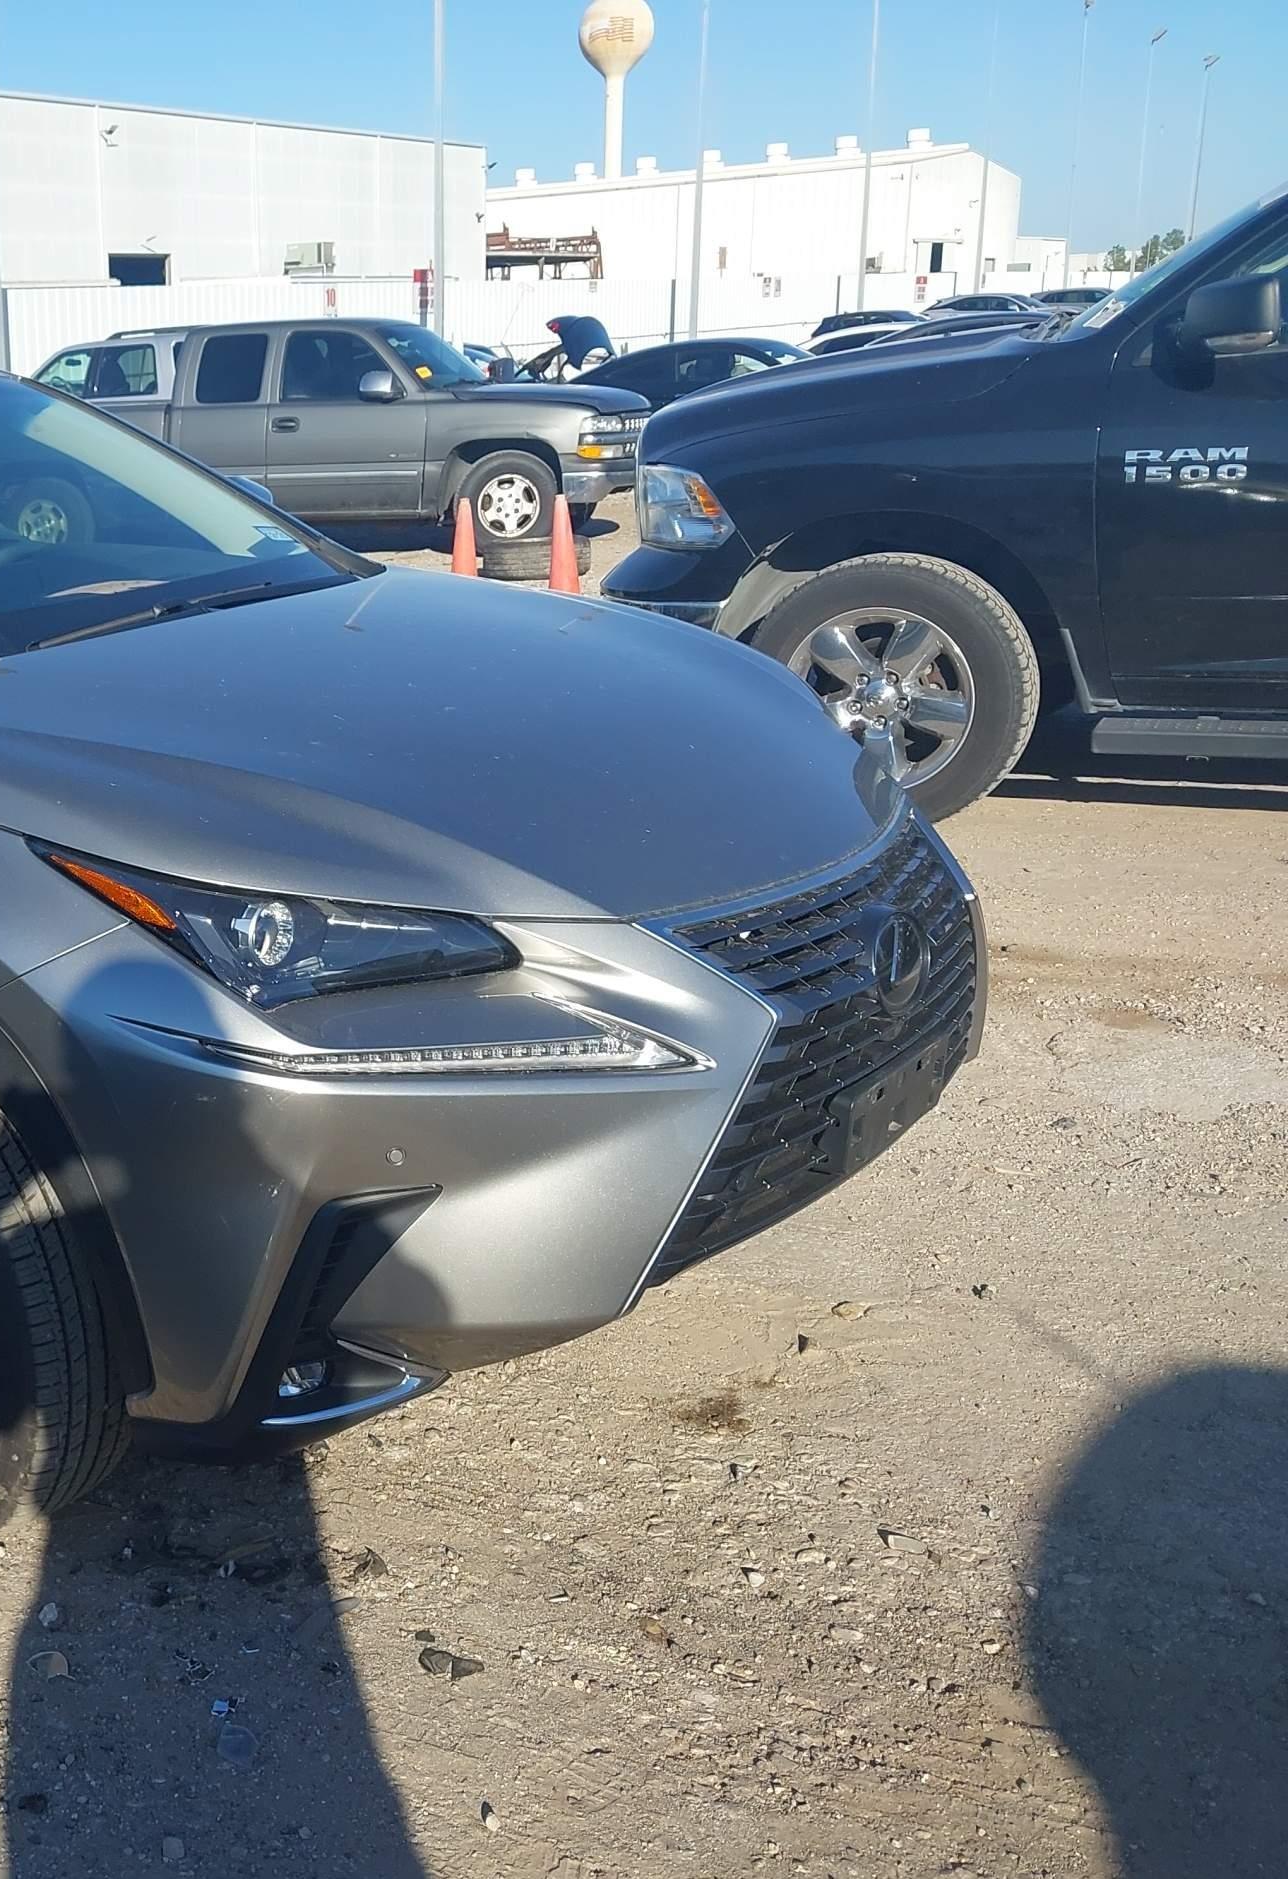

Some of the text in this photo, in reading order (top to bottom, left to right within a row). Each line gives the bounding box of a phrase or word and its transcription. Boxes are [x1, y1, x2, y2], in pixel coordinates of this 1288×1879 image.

[325, 287, 337, 308] 10
[1124, 446, 1249, 463] RAM
[1123, 463, 1249, 483] 1500
